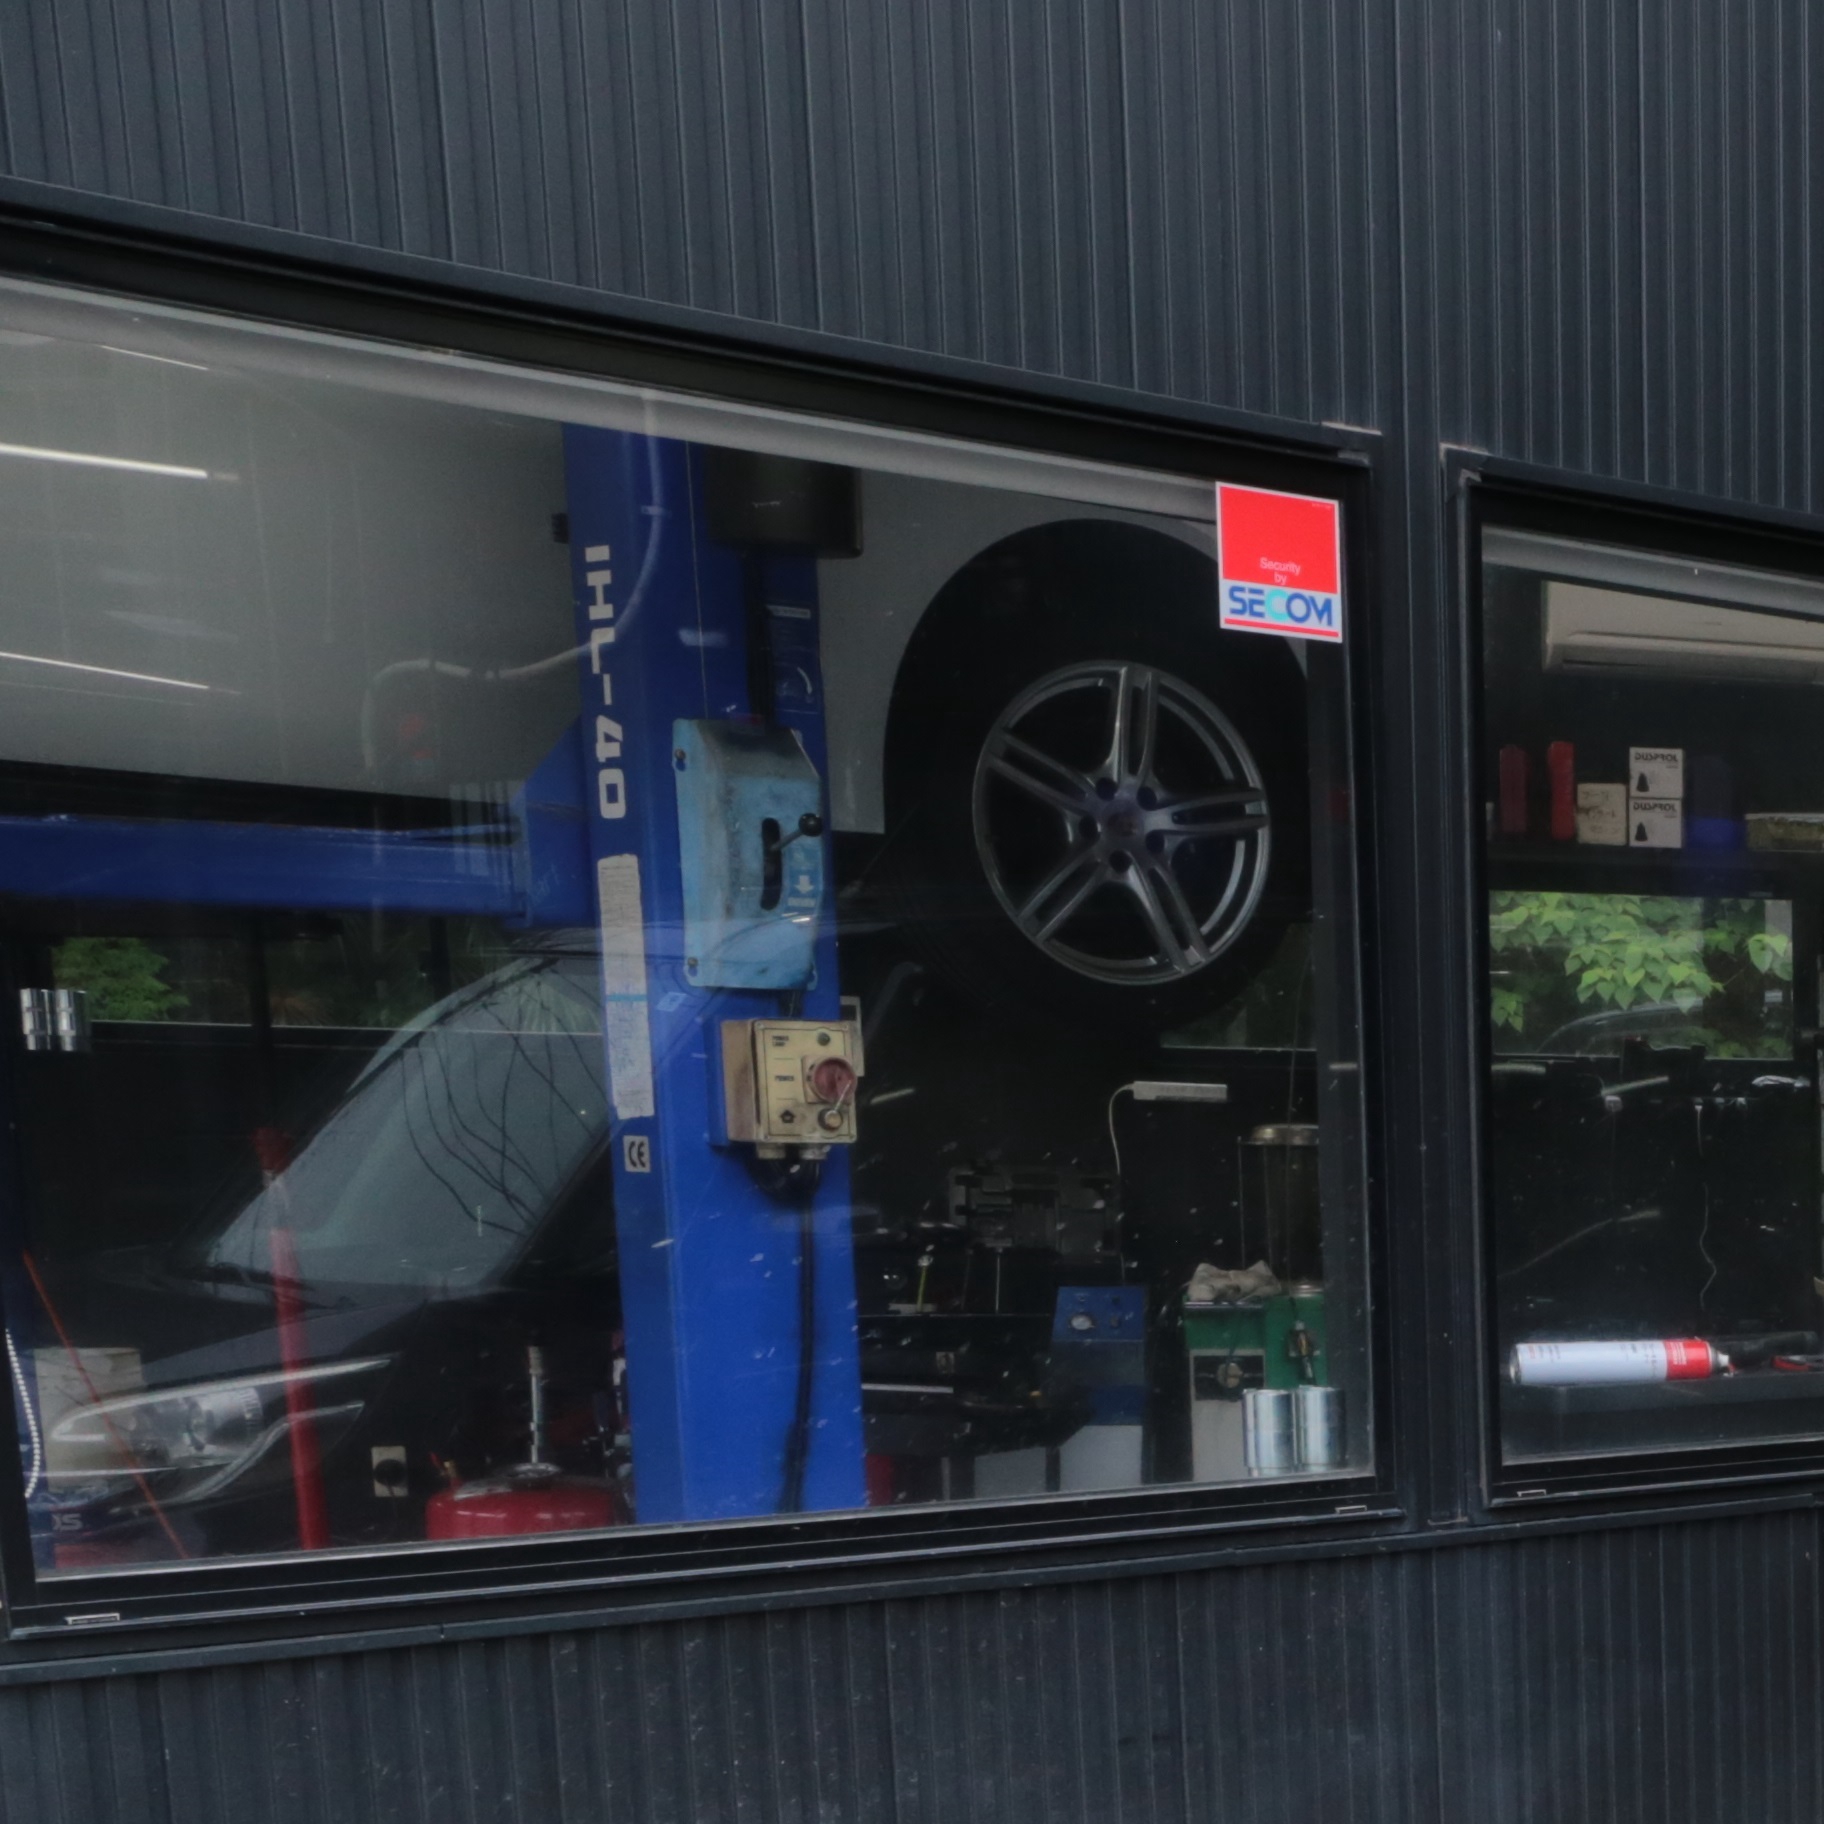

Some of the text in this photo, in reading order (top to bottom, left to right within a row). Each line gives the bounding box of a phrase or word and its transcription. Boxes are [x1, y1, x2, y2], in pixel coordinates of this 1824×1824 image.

[1259, 557, 1301, 576] Security
[1273, 572, 1287, 586] by
[1228, 585, 1333, 627] SECOM
[584, 544, 627, 820] IHL-40
[627, 1139, 647, 1168] CE
